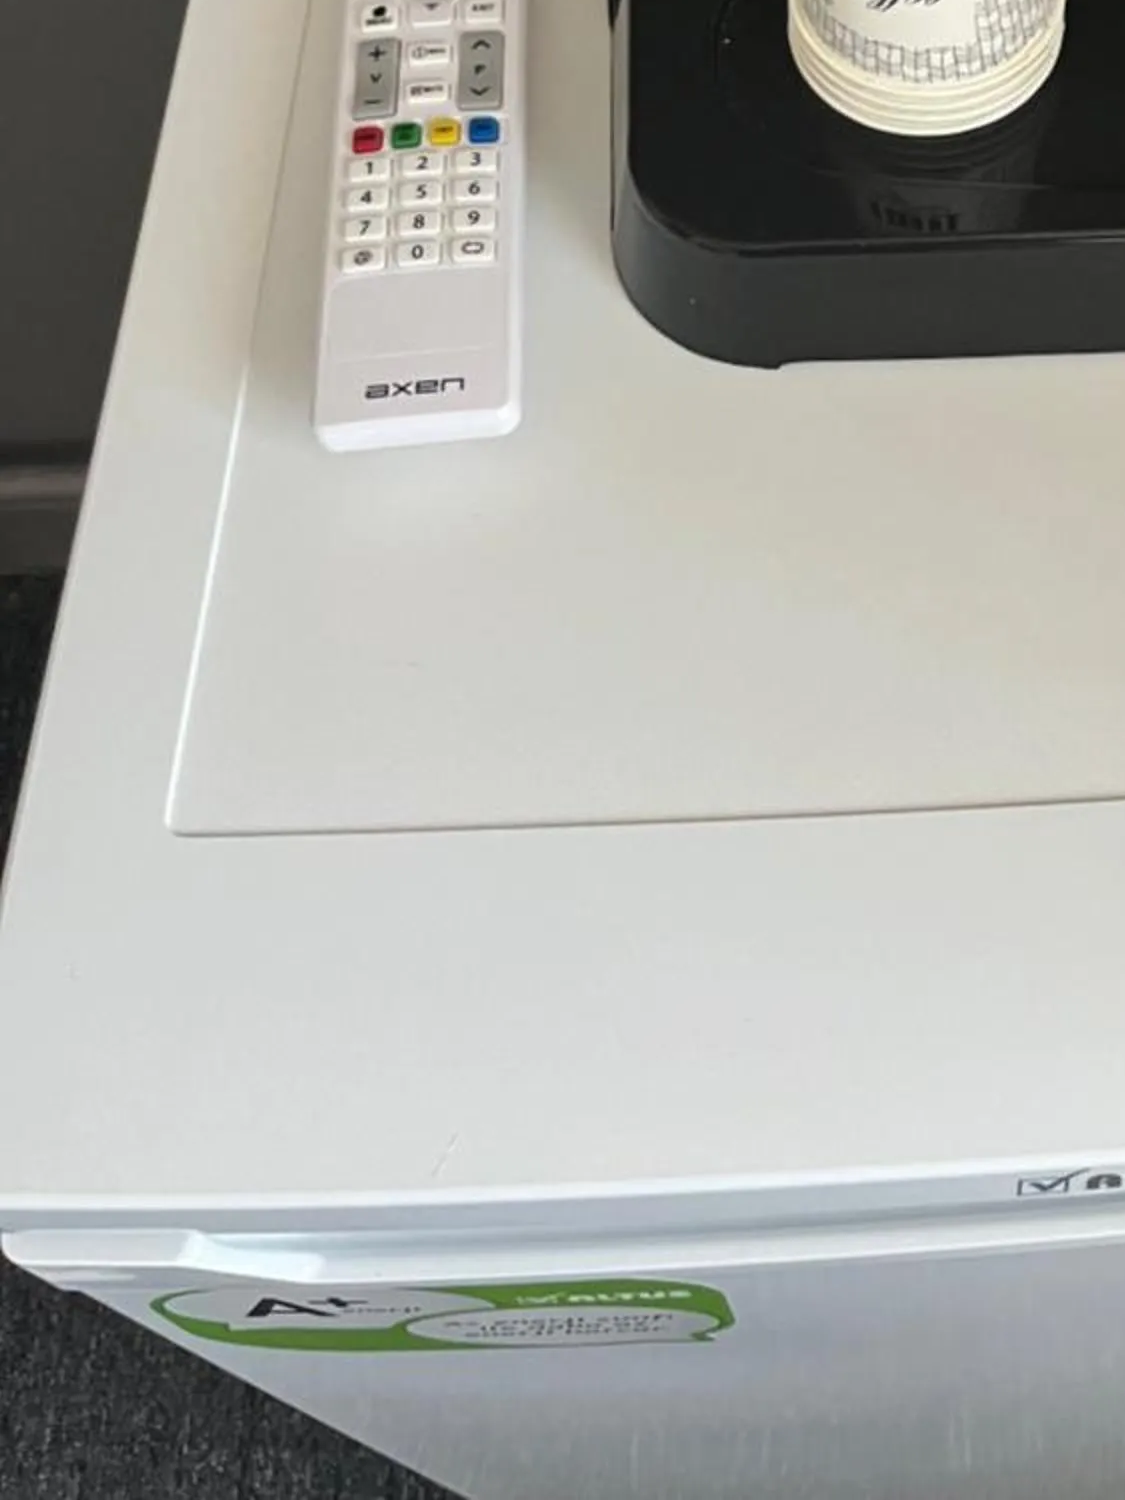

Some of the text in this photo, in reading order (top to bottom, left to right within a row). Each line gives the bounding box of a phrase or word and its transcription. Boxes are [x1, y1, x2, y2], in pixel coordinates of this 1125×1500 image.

[366, 152, 481, 174] 1 2 3
[360, 182, 480, 204] 4 5 6
[359, 211, 480, 234] 7 8 9
[411, 245, 424, 260] 0
[364, 376, 465, 400] axen
